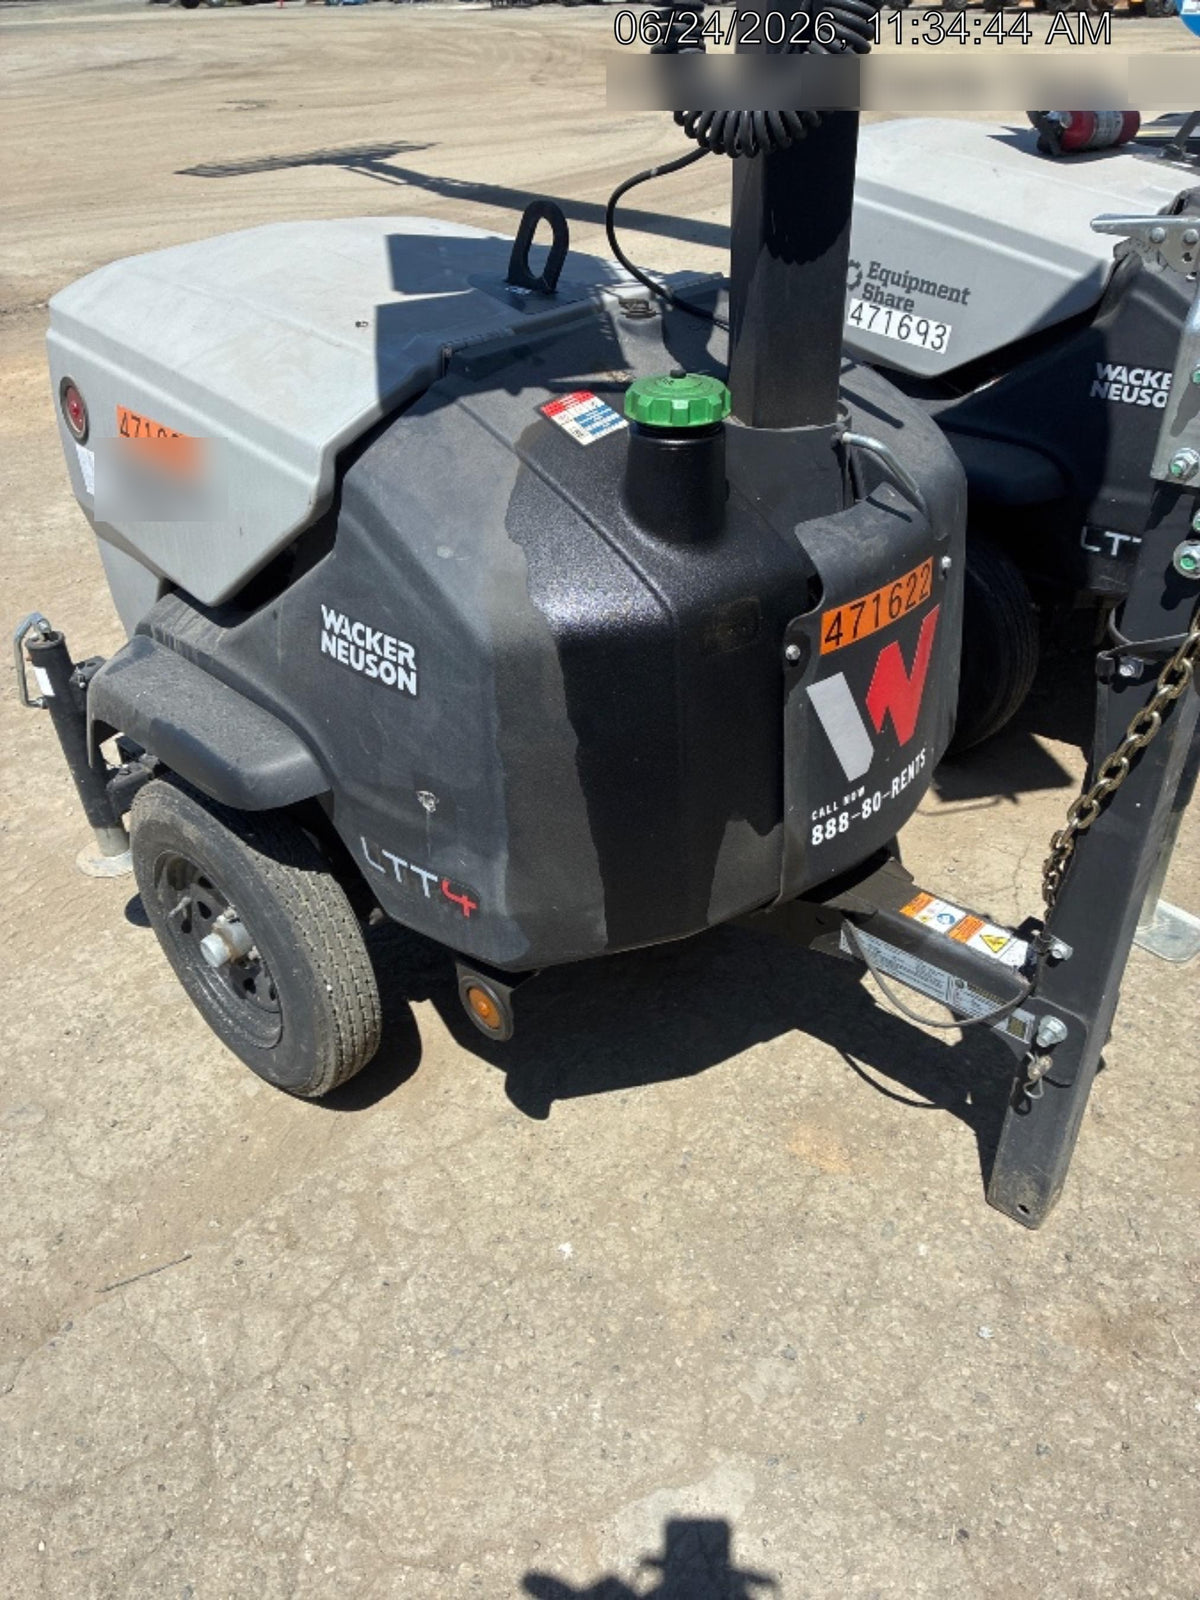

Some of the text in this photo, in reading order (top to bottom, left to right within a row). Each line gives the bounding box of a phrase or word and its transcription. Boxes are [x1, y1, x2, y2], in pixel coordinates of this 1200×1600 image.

[862, 282, 915, 313] Share
[867, 261, 971, 305] Equipment
[850, 302, 947, 350] 471693
[1081, 526, 1142, 556] LT
[825, 563, 931, 646] 471622
[321, 603, 417, 671] WACKER
[321, 629, 417, 695] NEUSON
[811, 786, 865, 821] CALL NOW
[360, 836, 477, 918] LTT4
